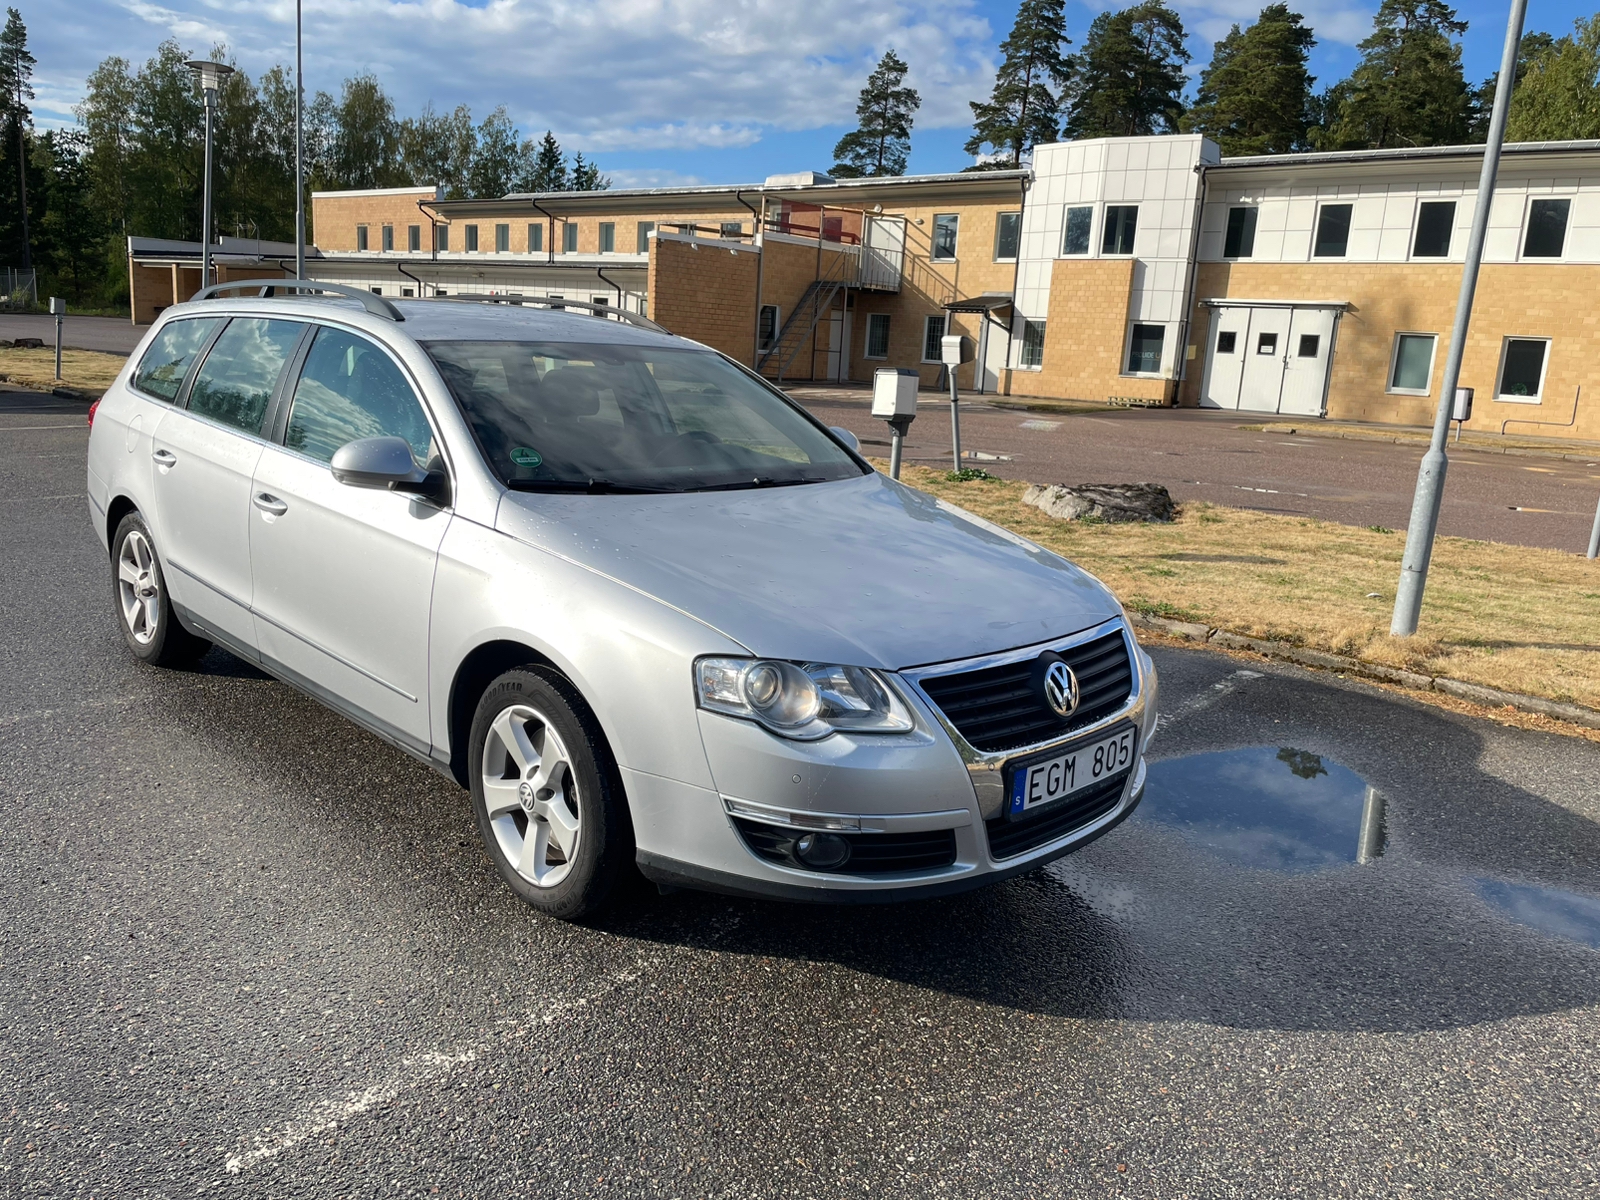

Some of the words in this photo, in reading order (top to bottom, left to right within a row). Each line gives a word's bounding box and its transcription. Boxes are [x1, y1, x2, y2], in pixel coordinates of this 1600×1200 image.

[480, 682, 522, 710] GOODYEAR
[1028, 755, 1076, 803] EGM
[1092, 734, 1130, 778] 805
[1015, 796, 1021, 805] S
